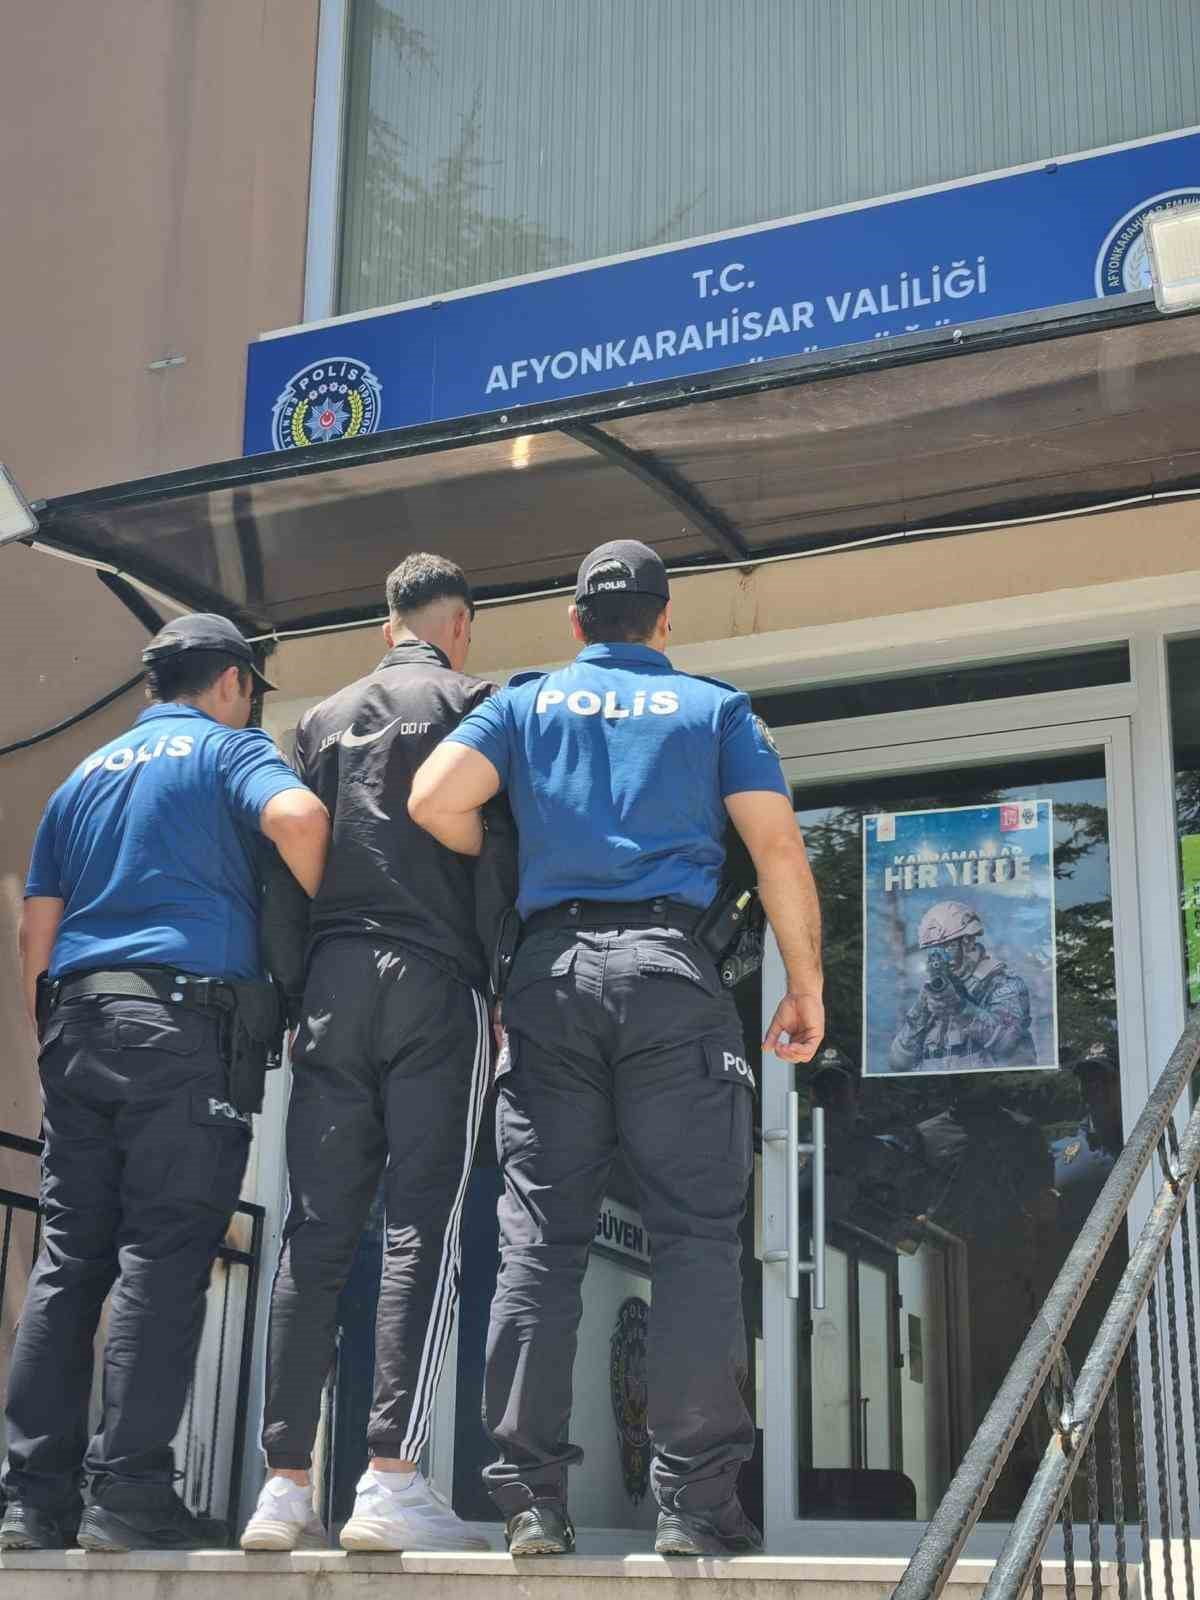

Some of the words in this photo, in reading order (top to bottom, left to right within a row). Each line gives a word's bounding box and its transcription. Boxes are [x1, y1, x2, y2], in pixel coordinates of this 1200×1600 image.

[692, 262, 755, 299] T.C.
[484, 300, 815, 395] AFYONKARAHİSAR
[825, 255, 988, 325] VALİLİĞİ
[298, 362, 359, 391] POLİS
[318, 729, 343, 753] JUST
[400, 721, 418, 736] DO
[418, 721, 432, 735] IT
